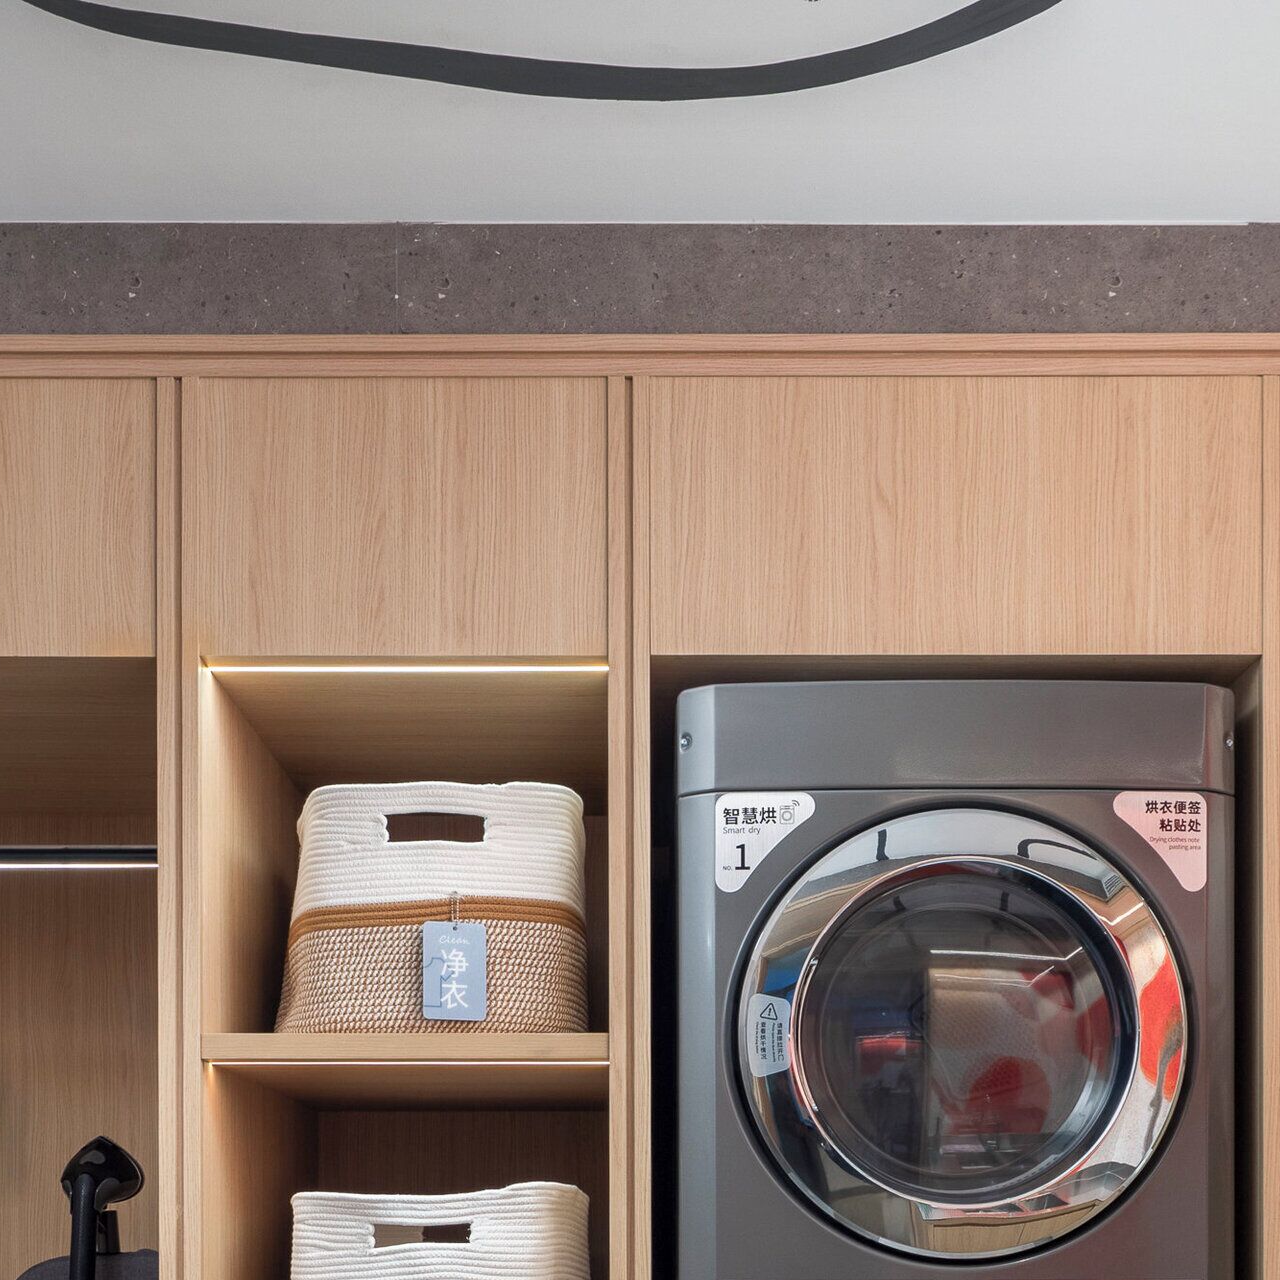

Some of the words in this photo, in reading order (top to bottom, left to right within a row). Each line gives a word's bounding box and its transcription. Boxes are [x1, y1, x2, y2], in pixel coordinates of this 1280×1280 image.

[1145, 800, 1201, 815] 烘衣便签
[723, 807, 777, 825] 智慧烘
[748, 826, 761, 835] dry
[1159, 818, 1201, 832] 粘贴处
[735, 843, 750, 870] 1
[440, 948, 469, 1009] 净衣
